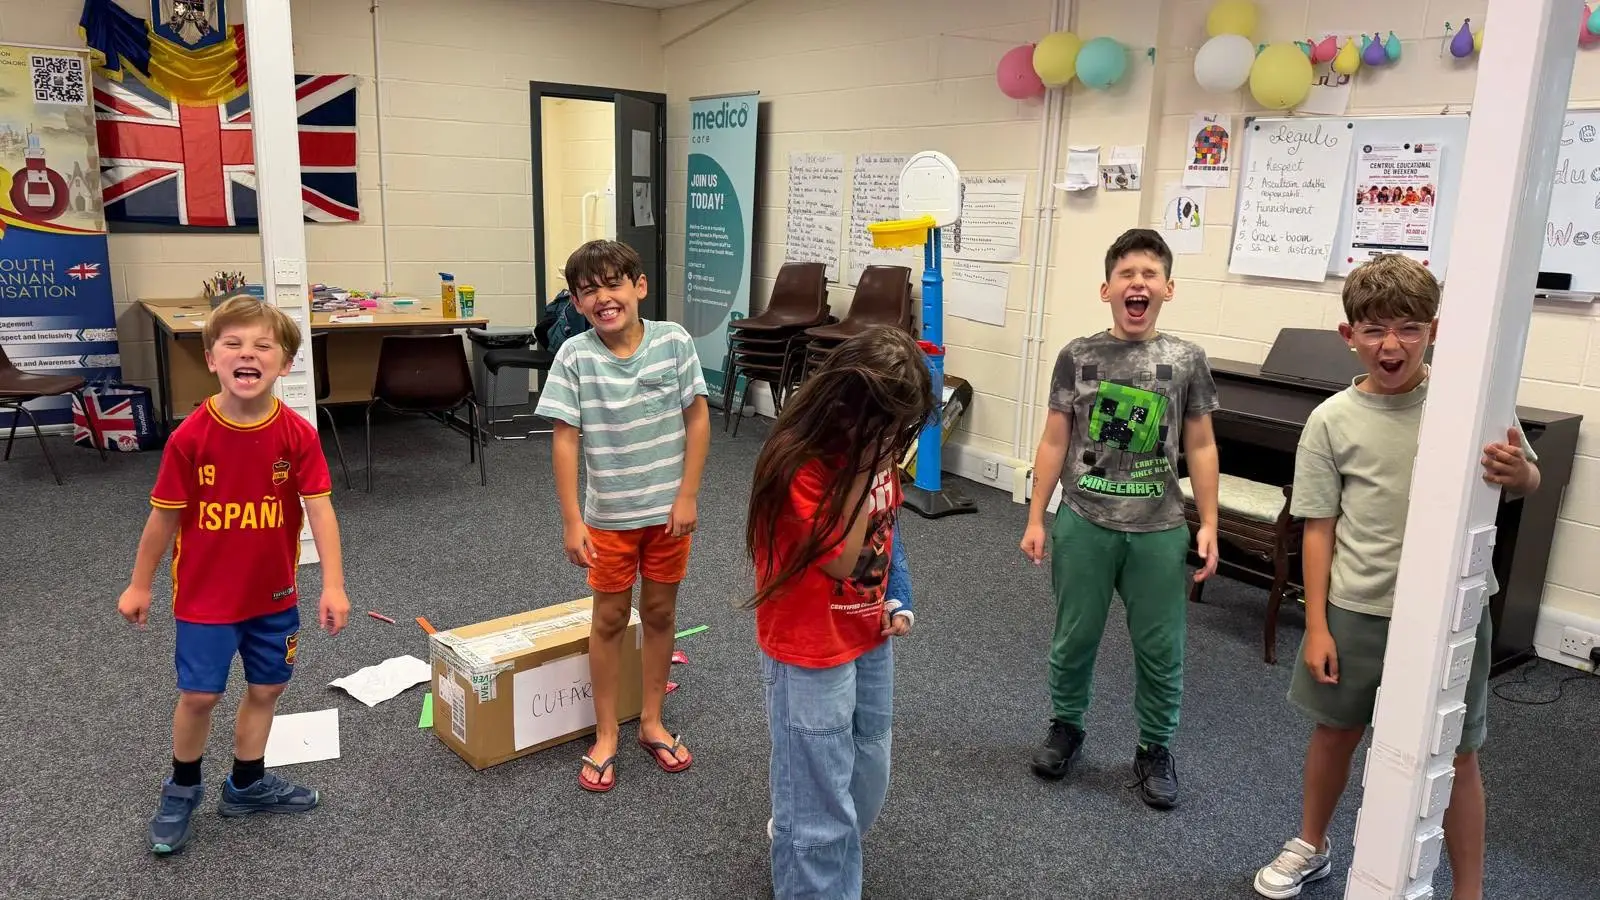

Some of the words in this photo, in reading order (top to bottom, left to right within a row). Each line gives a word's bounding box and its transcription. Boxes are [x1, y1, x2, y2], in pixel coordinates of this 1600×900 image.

[692, 102, 749, 130] medico
[692, 135, 710, 144] care
[1266, 157, 1304, 177] Respect
[691, 174, 706, 187] JOIN
[707, 174, 718, 187] US
[691, 193, 724, 210] TODAY!
[0, 286, 76, 298] ISATION
[23, 331, 36, 340] and
[38, 331, 73, 340] Inclusivity
[137, 404, 149, 435] Poundland
[198, 464, 216, 486] 19
[1130, 469, 1153, 478] SINCE
[1078, 475, 1164, 498] MINECRAFT
[532, 679, 593, 718] CUFĂR
